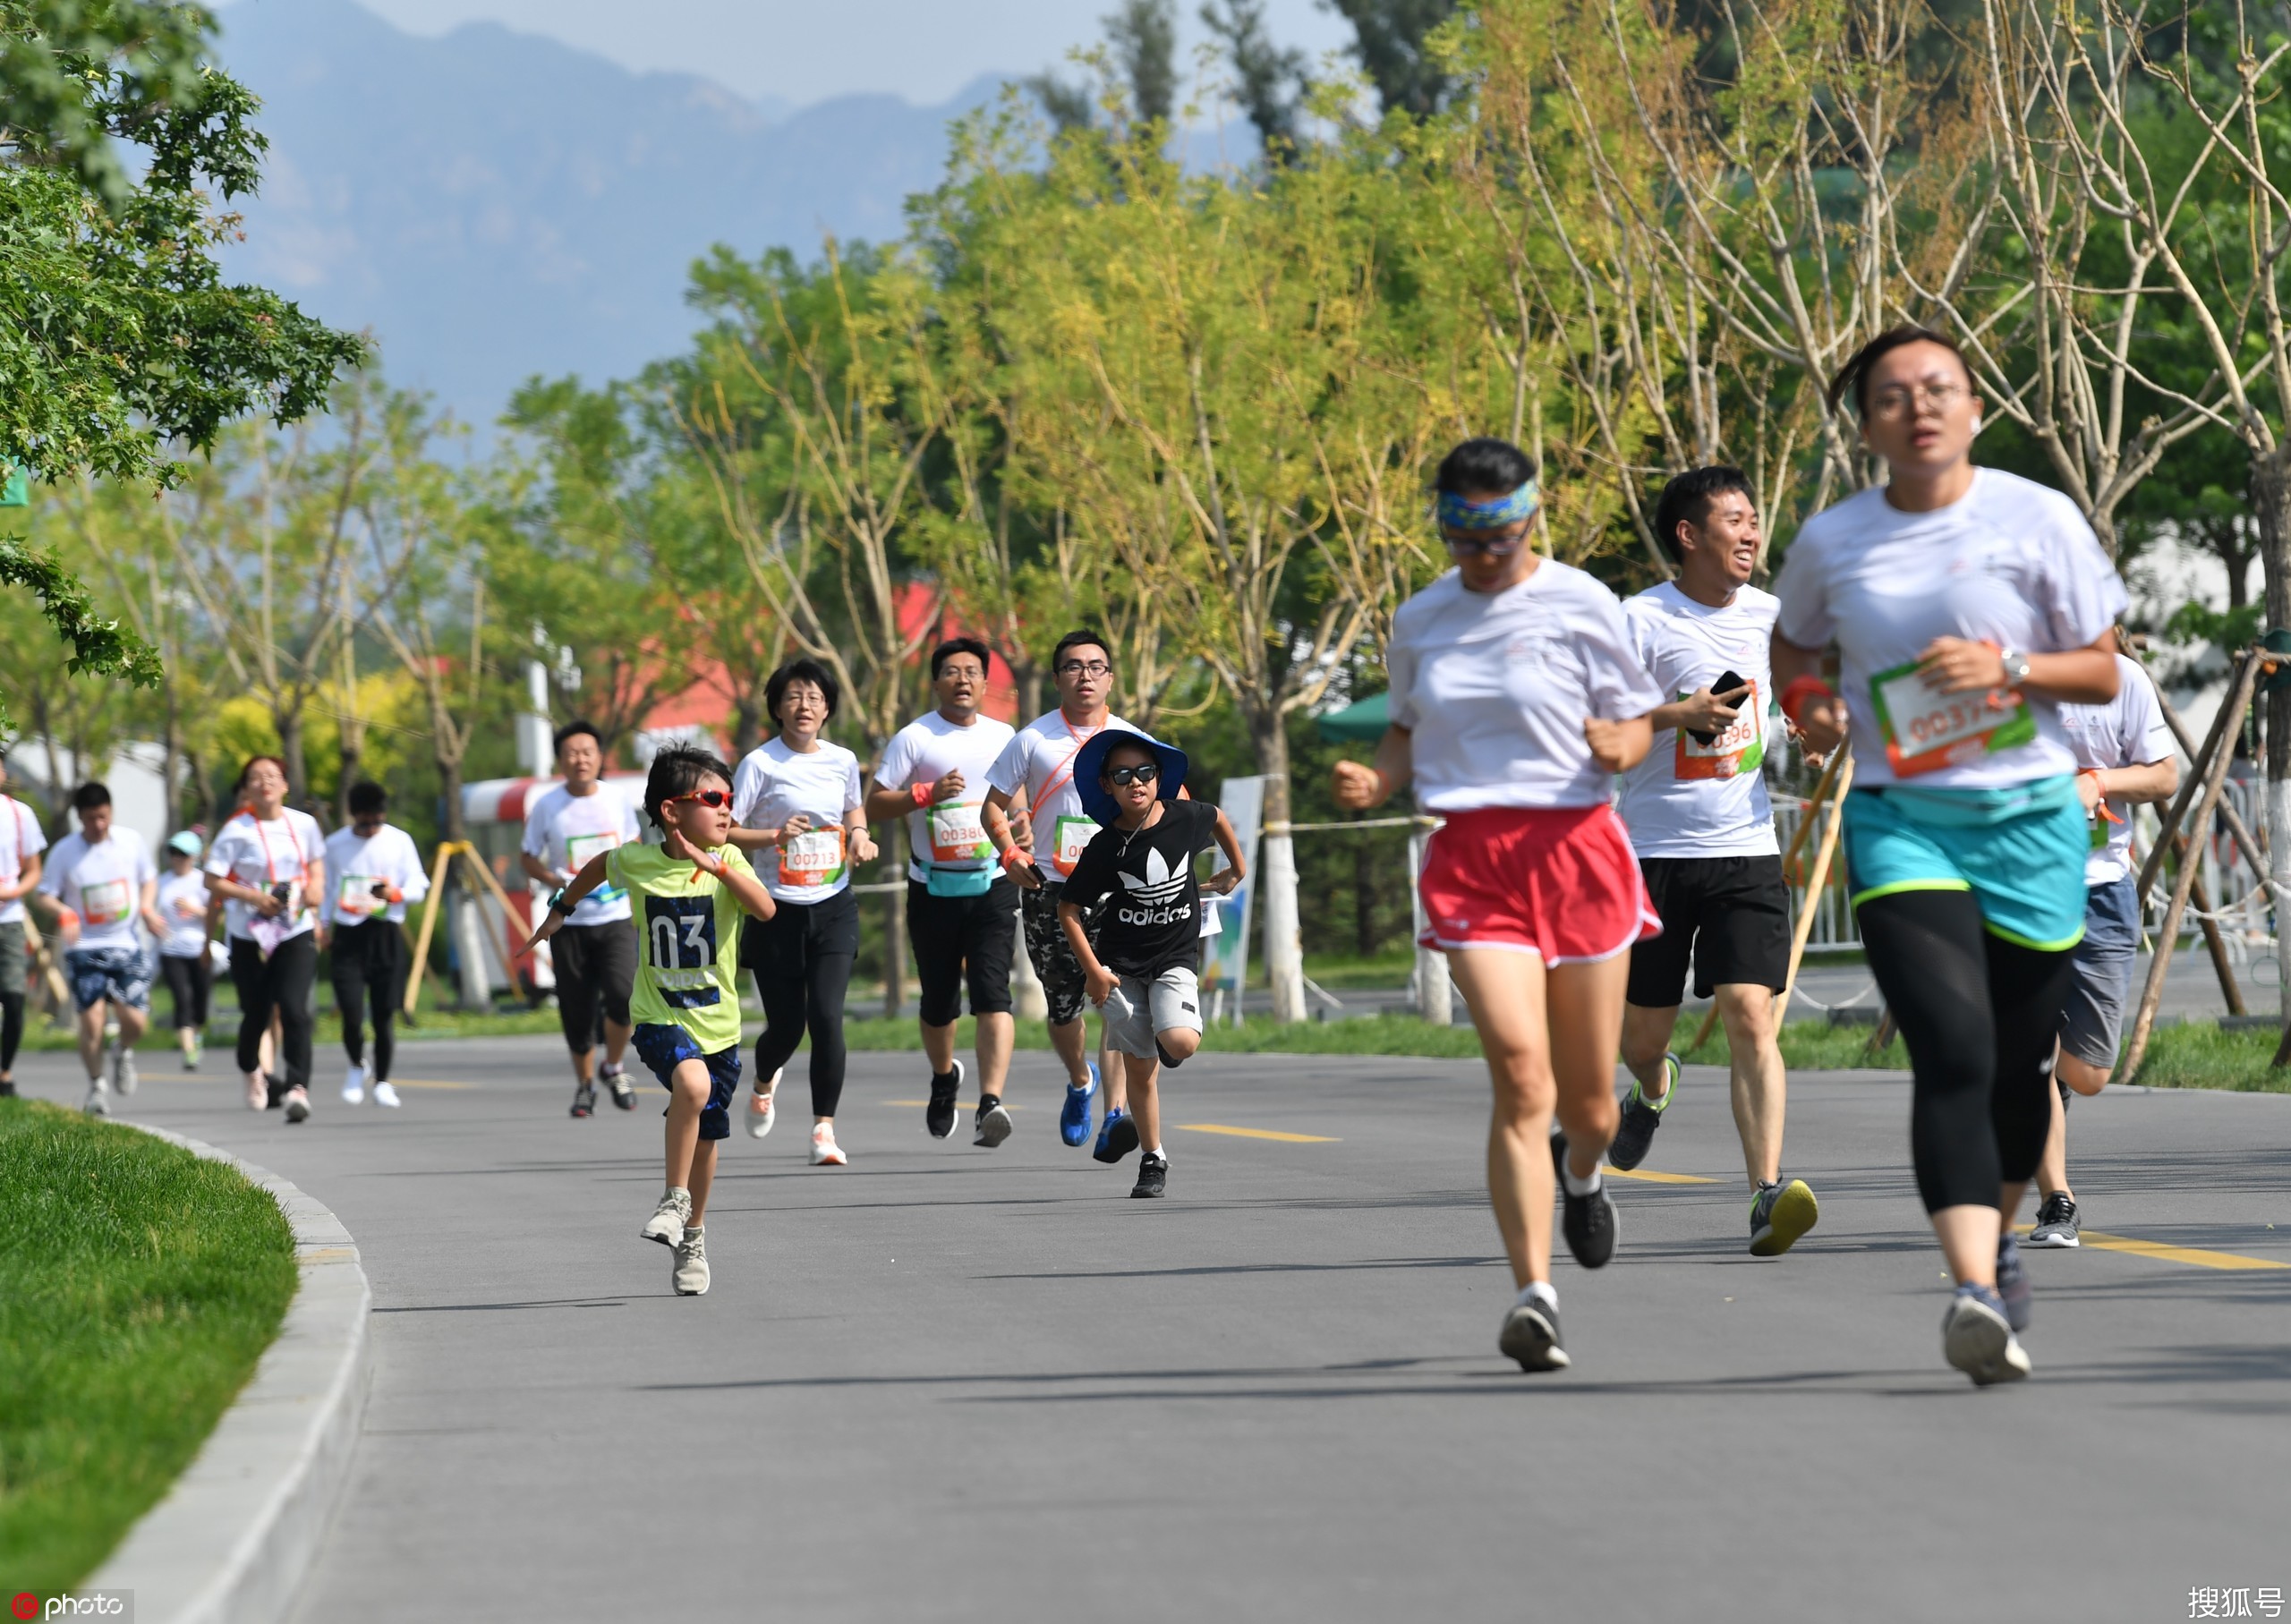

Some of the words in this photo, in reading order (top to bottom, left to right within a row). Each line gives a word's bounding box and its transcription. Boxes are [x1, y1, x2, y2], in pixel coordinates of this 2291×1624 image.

[1697, 722, 1751, 750] 0396
[793, 852, 836, 865] 00713
[1118, 903, 1192, 926] adidas
[651, 914, 711, 969] 03
